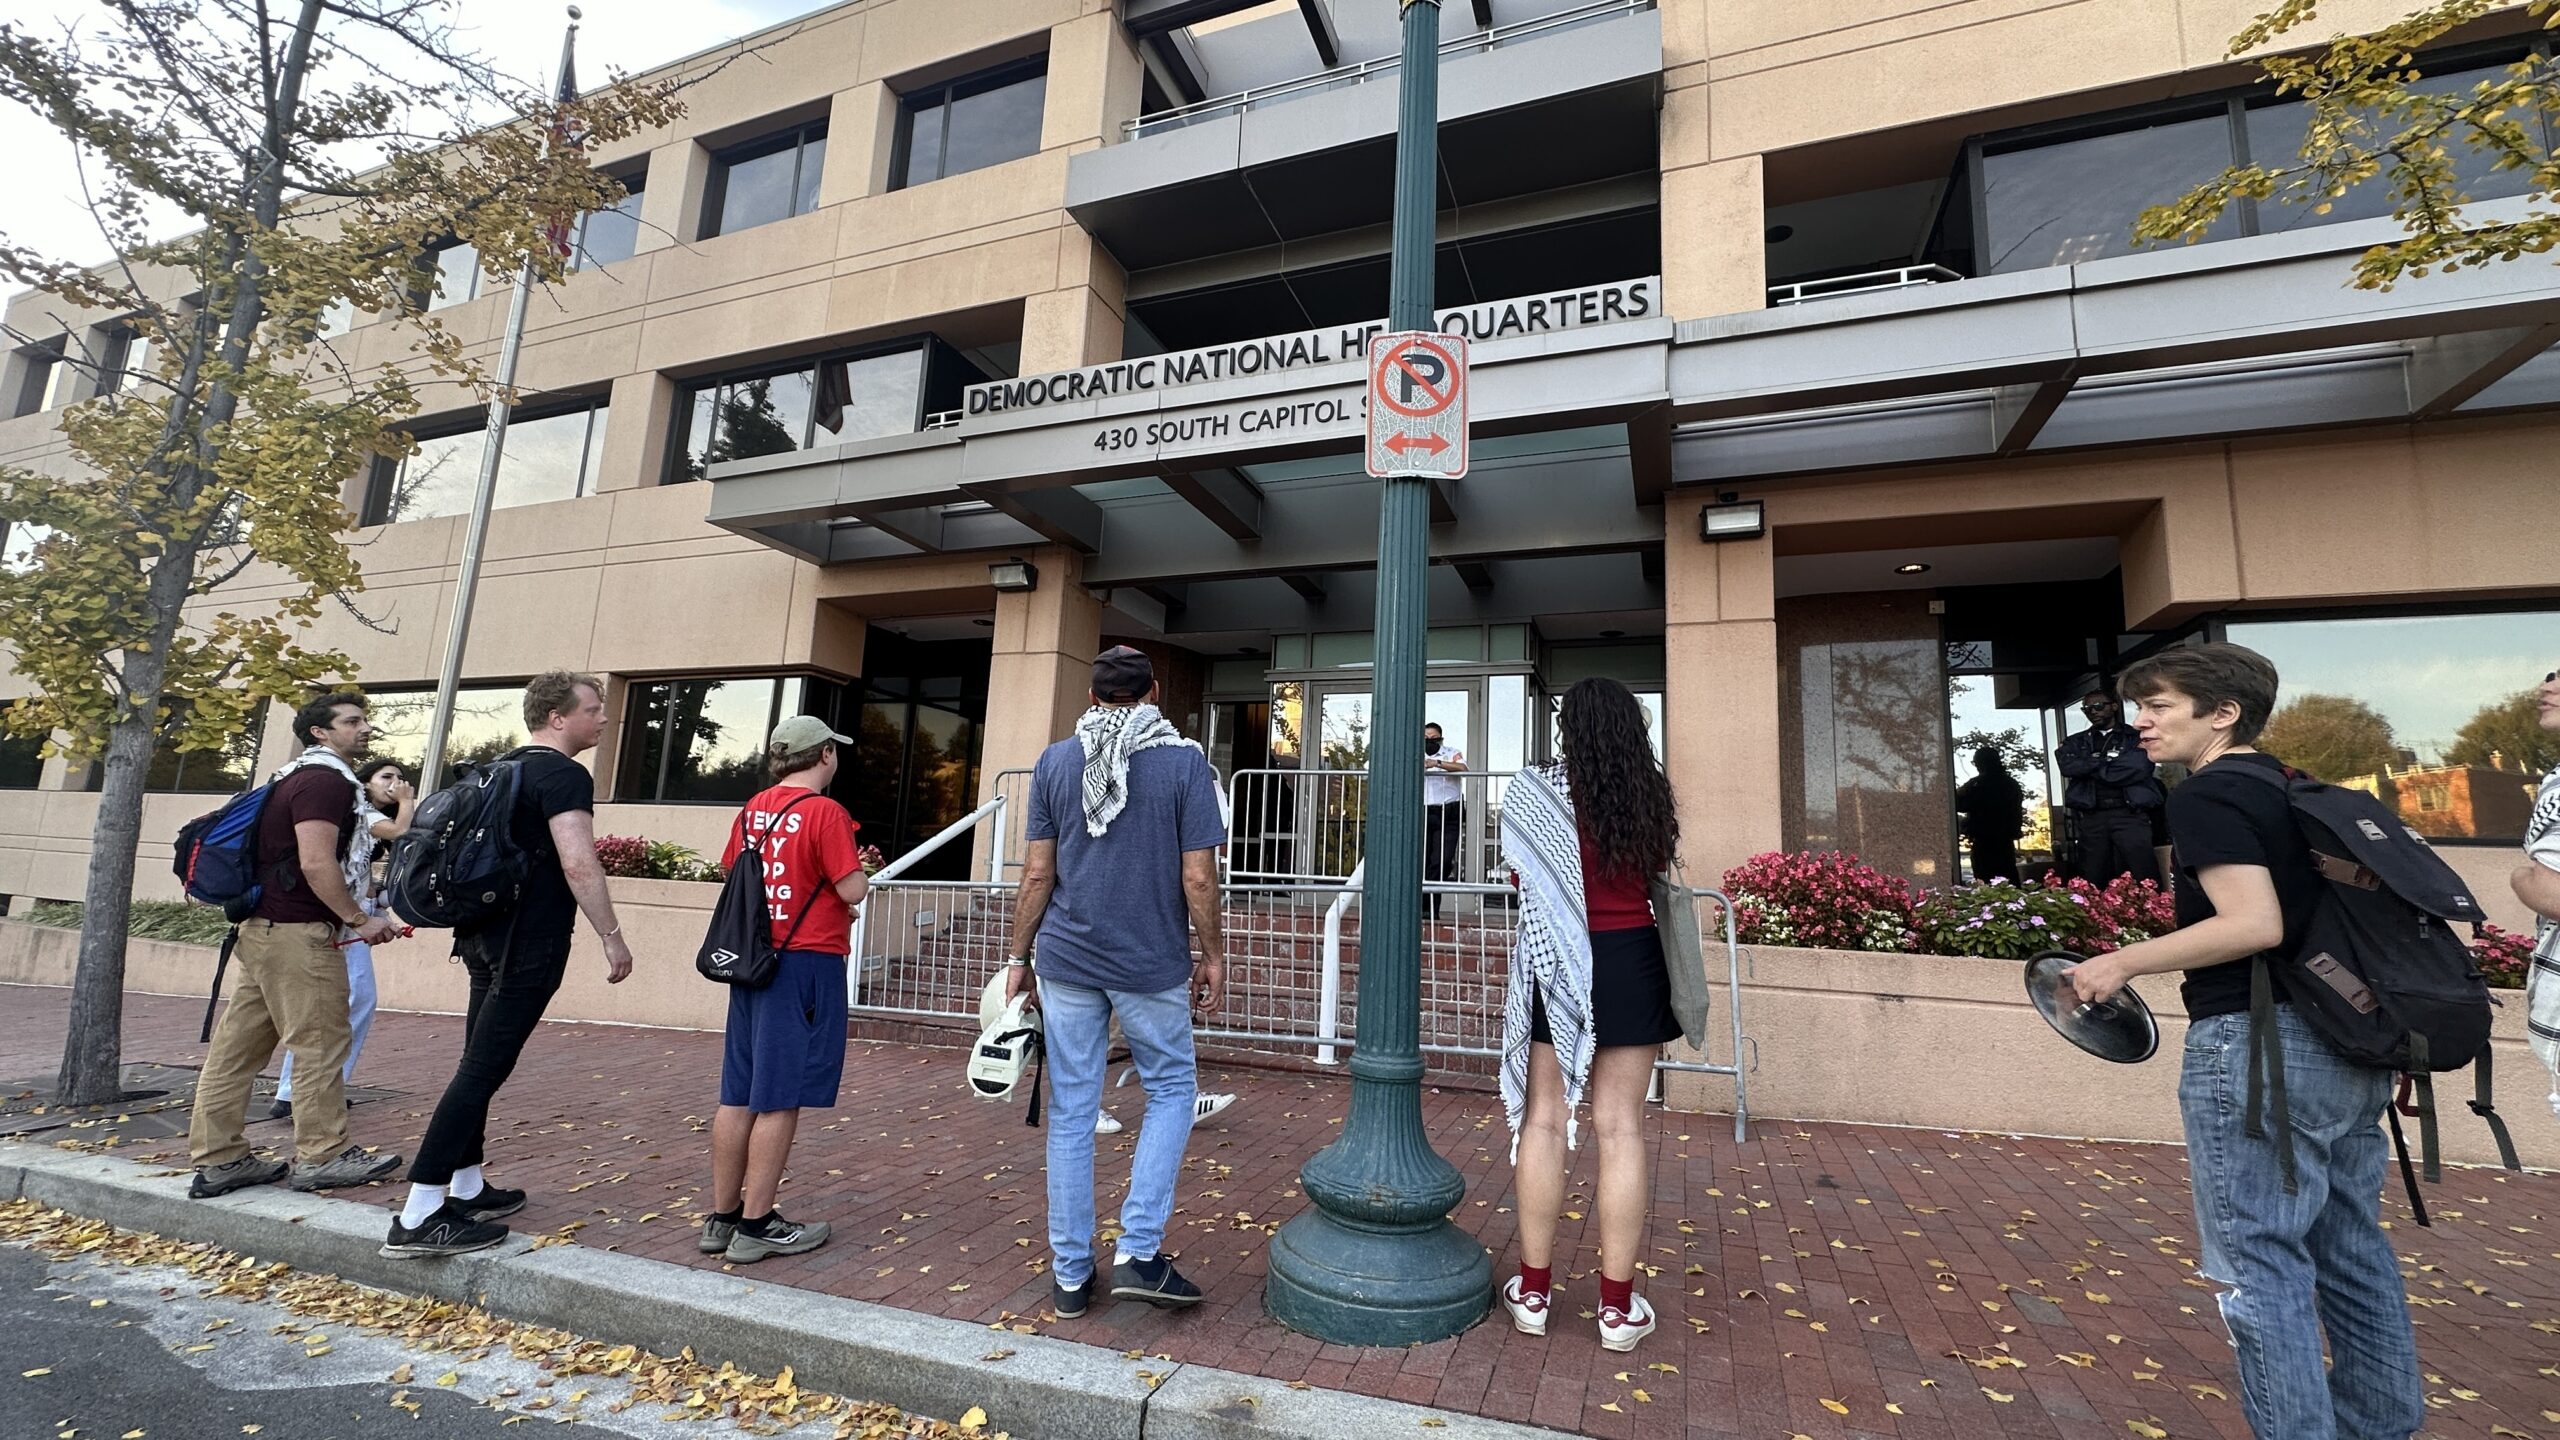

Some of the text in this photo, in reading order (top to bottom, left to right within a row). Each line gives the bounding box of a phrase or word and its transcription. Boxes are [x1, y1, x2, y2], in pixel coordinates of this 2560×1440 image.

[968, 360, 1156, 415] DEMOCRATIC
[1162, 334, 1331, 385] NATIONAL
[1093, 426, 1138, 451] 430
[1145, 414, 1230, 445] SOUTH
[1238, 399, 1351, 433] CAPITOL
